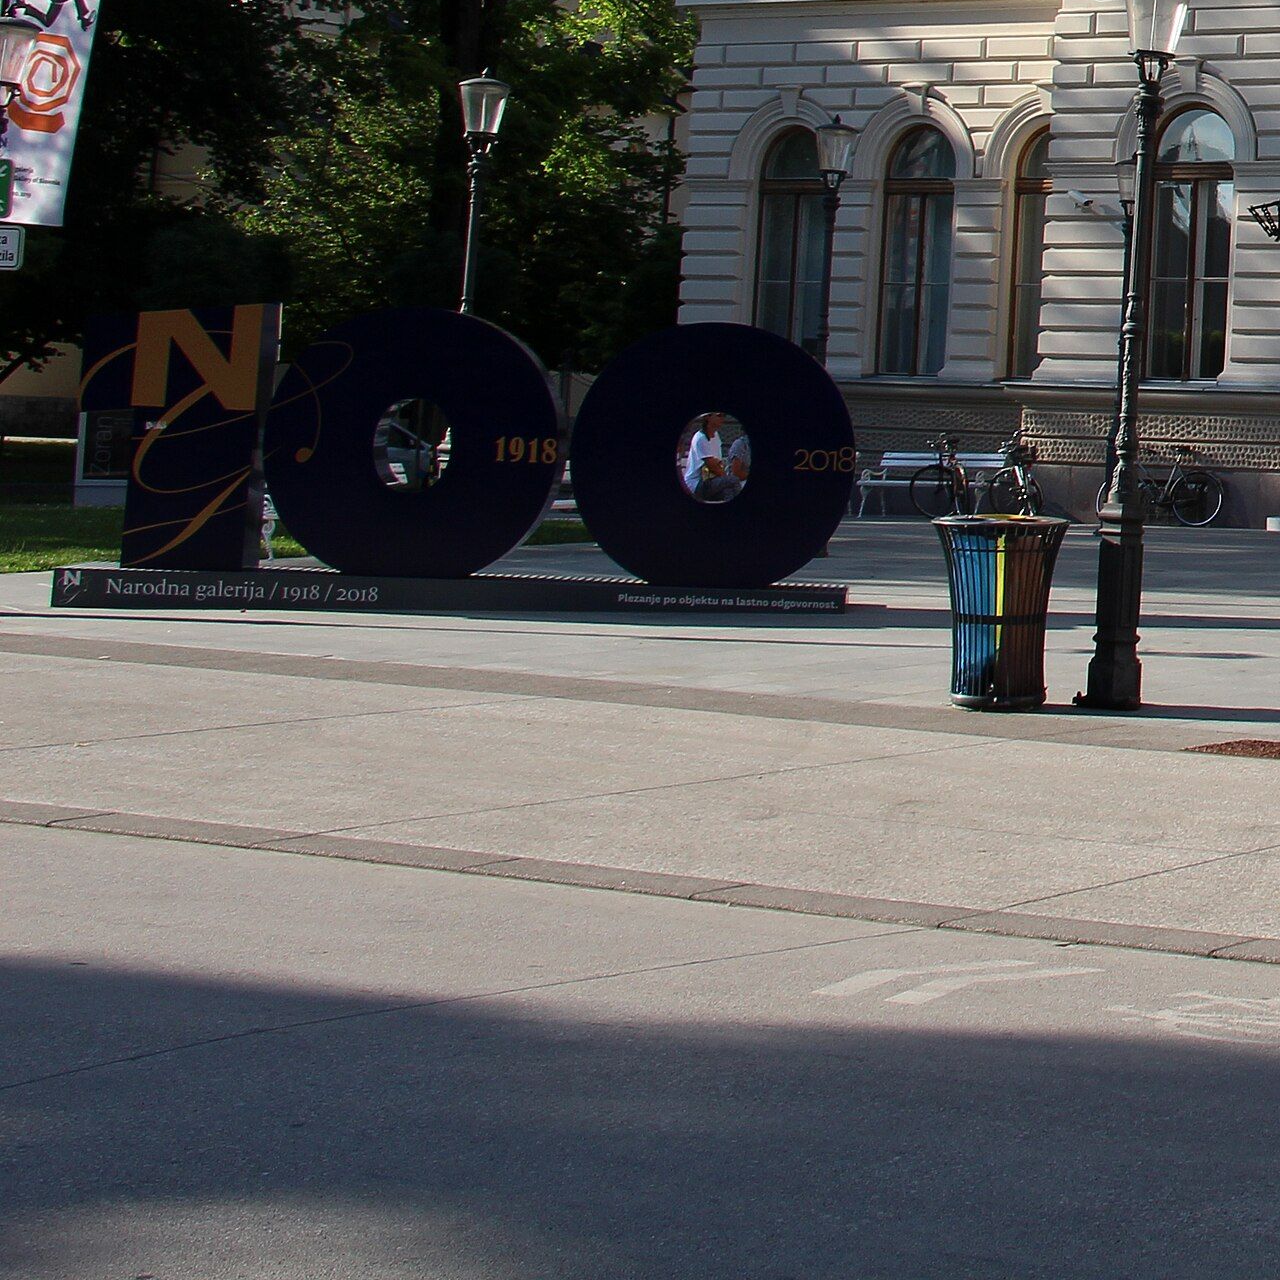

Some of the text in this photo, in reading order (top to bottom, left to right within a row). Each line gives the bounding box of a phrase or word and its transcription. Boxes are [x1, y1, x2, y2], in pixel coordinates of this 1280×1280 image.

[495, 436, 558, 464] 1918
[793, 447, 855, 472] 2018
[106, 578, 190, 596] Narodna
[195, 580, 265, 601] galerija
[282, 584, 320, 602] 1918
[336, 586, 379, 602] 2018
[617, 593, 839, 610] Plezanje po objektu na lastno odgovornost.
